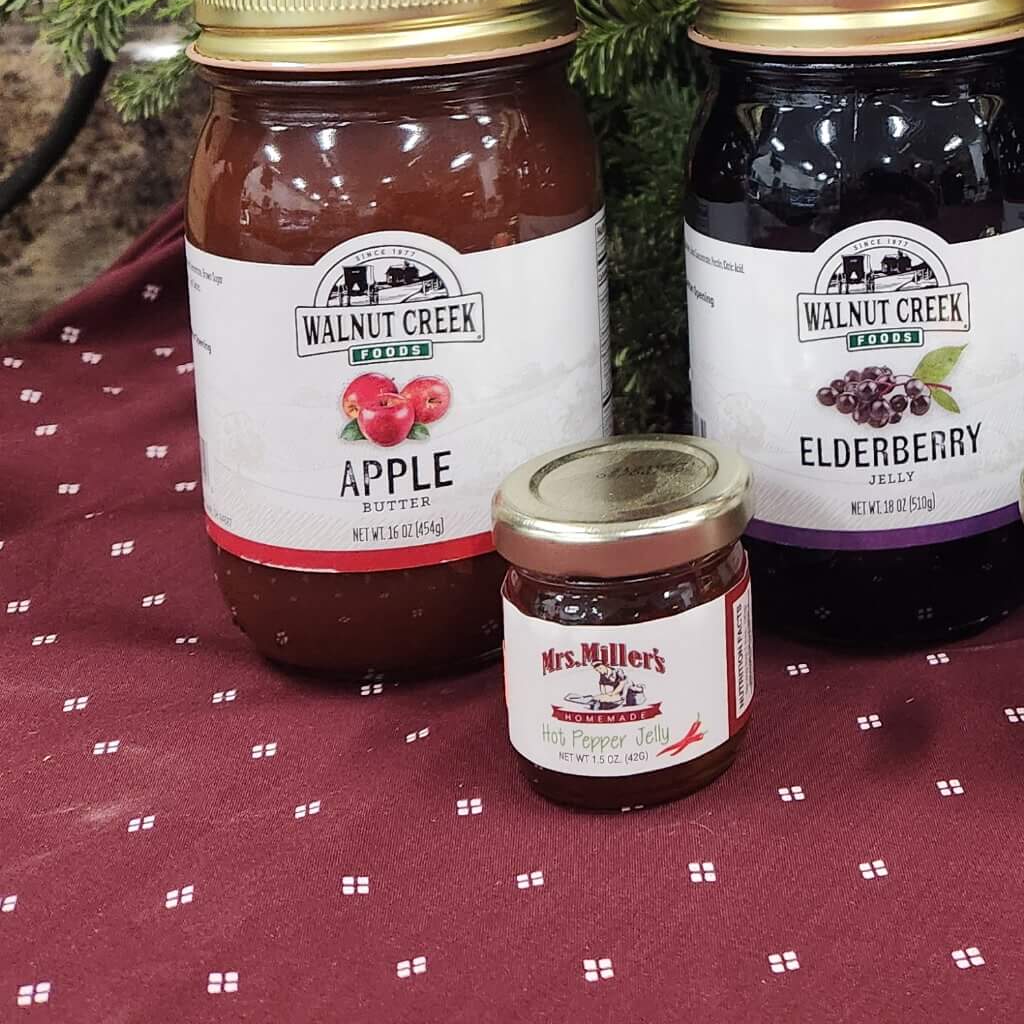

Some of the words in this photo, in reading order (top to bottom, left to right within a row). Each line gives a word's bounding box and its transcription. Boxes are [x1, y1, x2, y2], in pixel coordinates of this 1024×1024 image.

[854, 239, 882, 251] SINCE
[356, 249, 386, 263] SINCE
[803, 299, 889, 331] WALNUT
[896, 292, 963, 323] CREEK
[303, 312, 396, 346] WALNUT
[403, 303, 477, 337] CREEK
[856, 333, 913, 346] FOODS
[361, 345, 422, 360] FOODS
[800, 422, 982, 468] ELDERBERRY
[340, 450, 453, 498] APPLE
[868, 471, 915, 485] JELLY
[362, 496, 431, 513] BUTTER
[851, 501, 867, 516] NET
[884, 499, 894, 513] 18
[896, 497, 907, 512] OZ
[908, 492, 937, 513] (510g)
[353, 528, 369, 542] NET
[389, 525, 400, 539] 16
[402, 523, 413, 538] OZ
[415, 517, 444, 538] (454g)
[564, 712, 646, 722] HOMEMADE
[542, 724, 566, 747] Hot
[572, 729, 627, 753] Pepper
[635, 726, 669, 746] Jelly
[559, 752, 573, 762] NET
[576, 754, 590, 763] WT
[624, 750, 649, 763] (42G)
